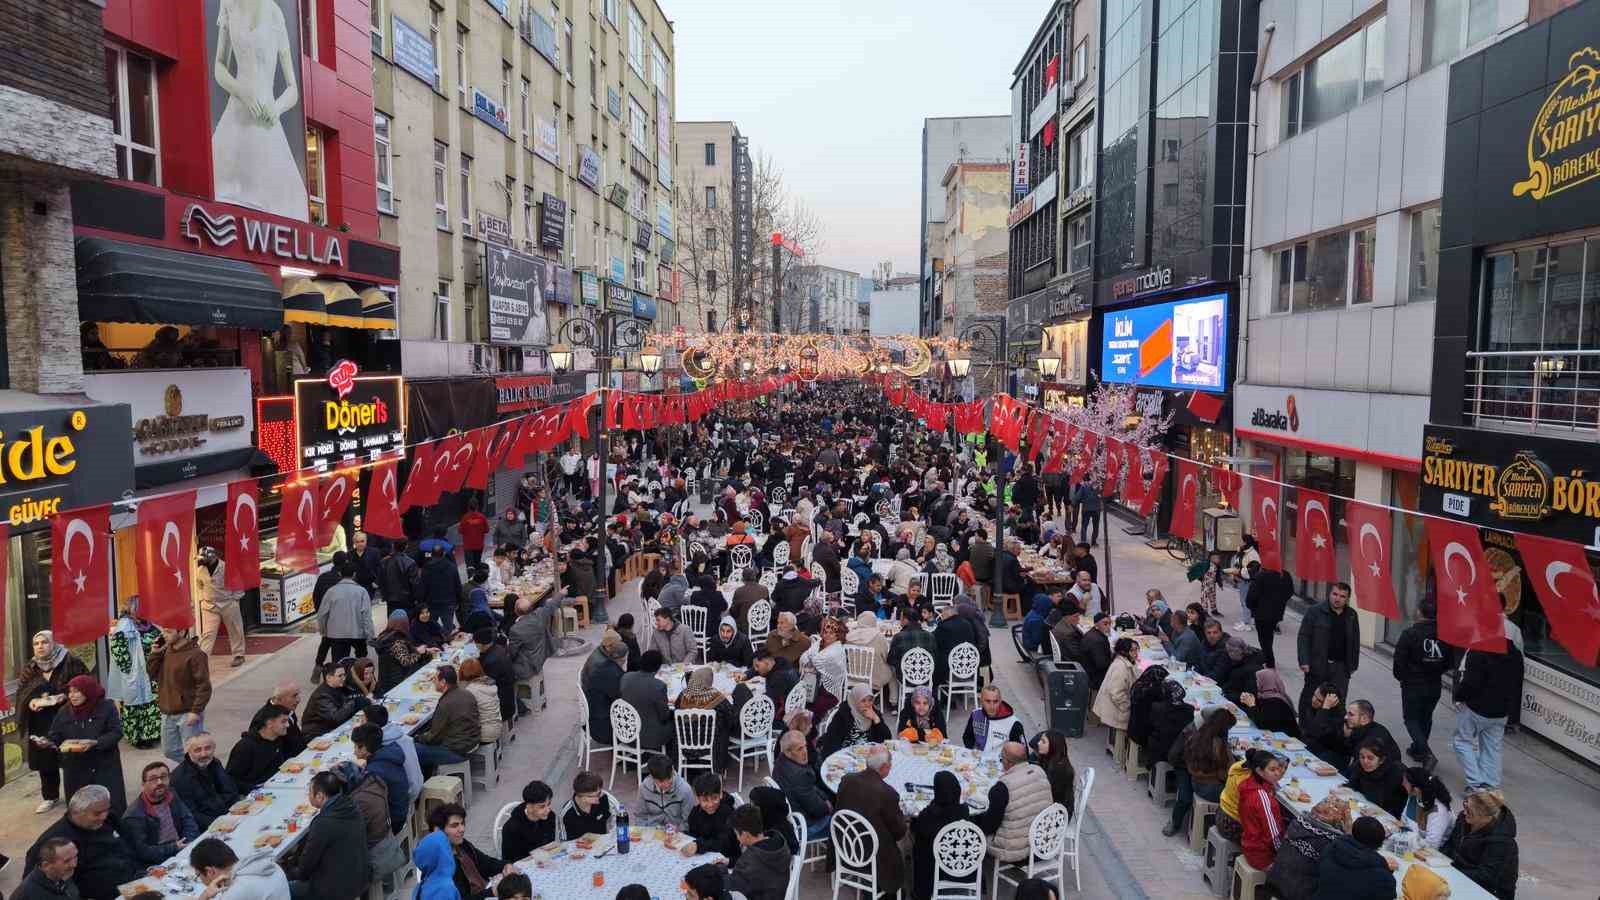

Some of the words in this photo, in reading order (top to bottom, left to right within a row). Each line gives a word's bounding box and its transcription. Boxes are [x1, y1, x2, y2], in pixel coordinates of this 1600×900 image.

[1539, 102, 1600, 158] SARIY
[242, 216, 345, 267] WELLA
[1252, 408, 1288, 431] alBaraka
[1424, 455, 1497, 497] SARIYER
[1503, 480, 1542, 499] SARIYER
[1423, 638, 1444, 659] CK
